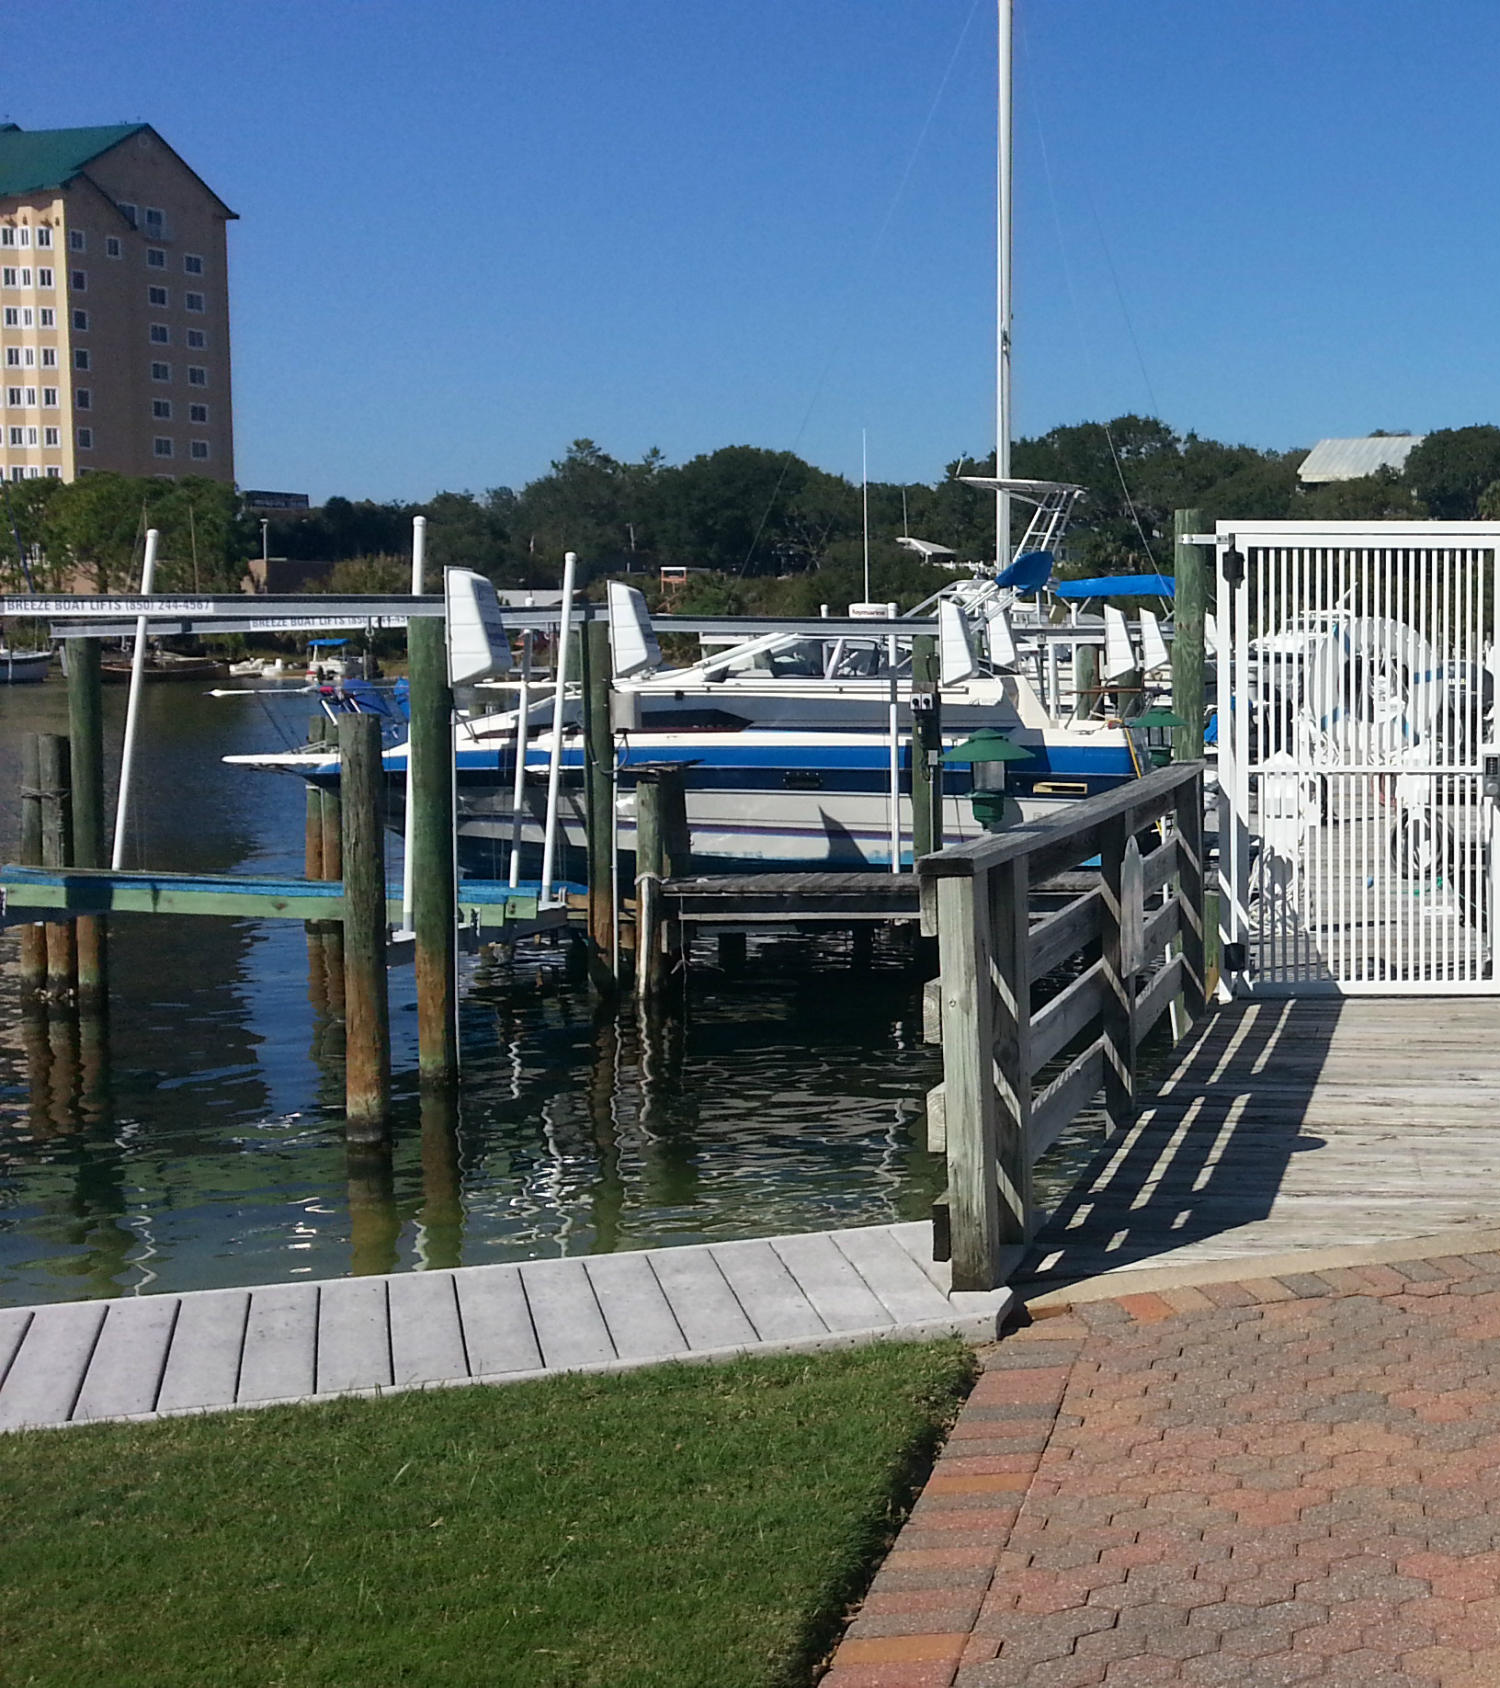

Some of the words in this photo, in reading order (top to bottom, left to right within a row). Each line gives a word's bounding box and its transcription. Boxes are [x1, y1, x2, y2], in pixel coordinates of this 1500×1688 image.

[7, 600, 51, 610] BREEZE
[55, 600, 85, 610] BOAT
[90, 600, 121, 610] LIFTS
